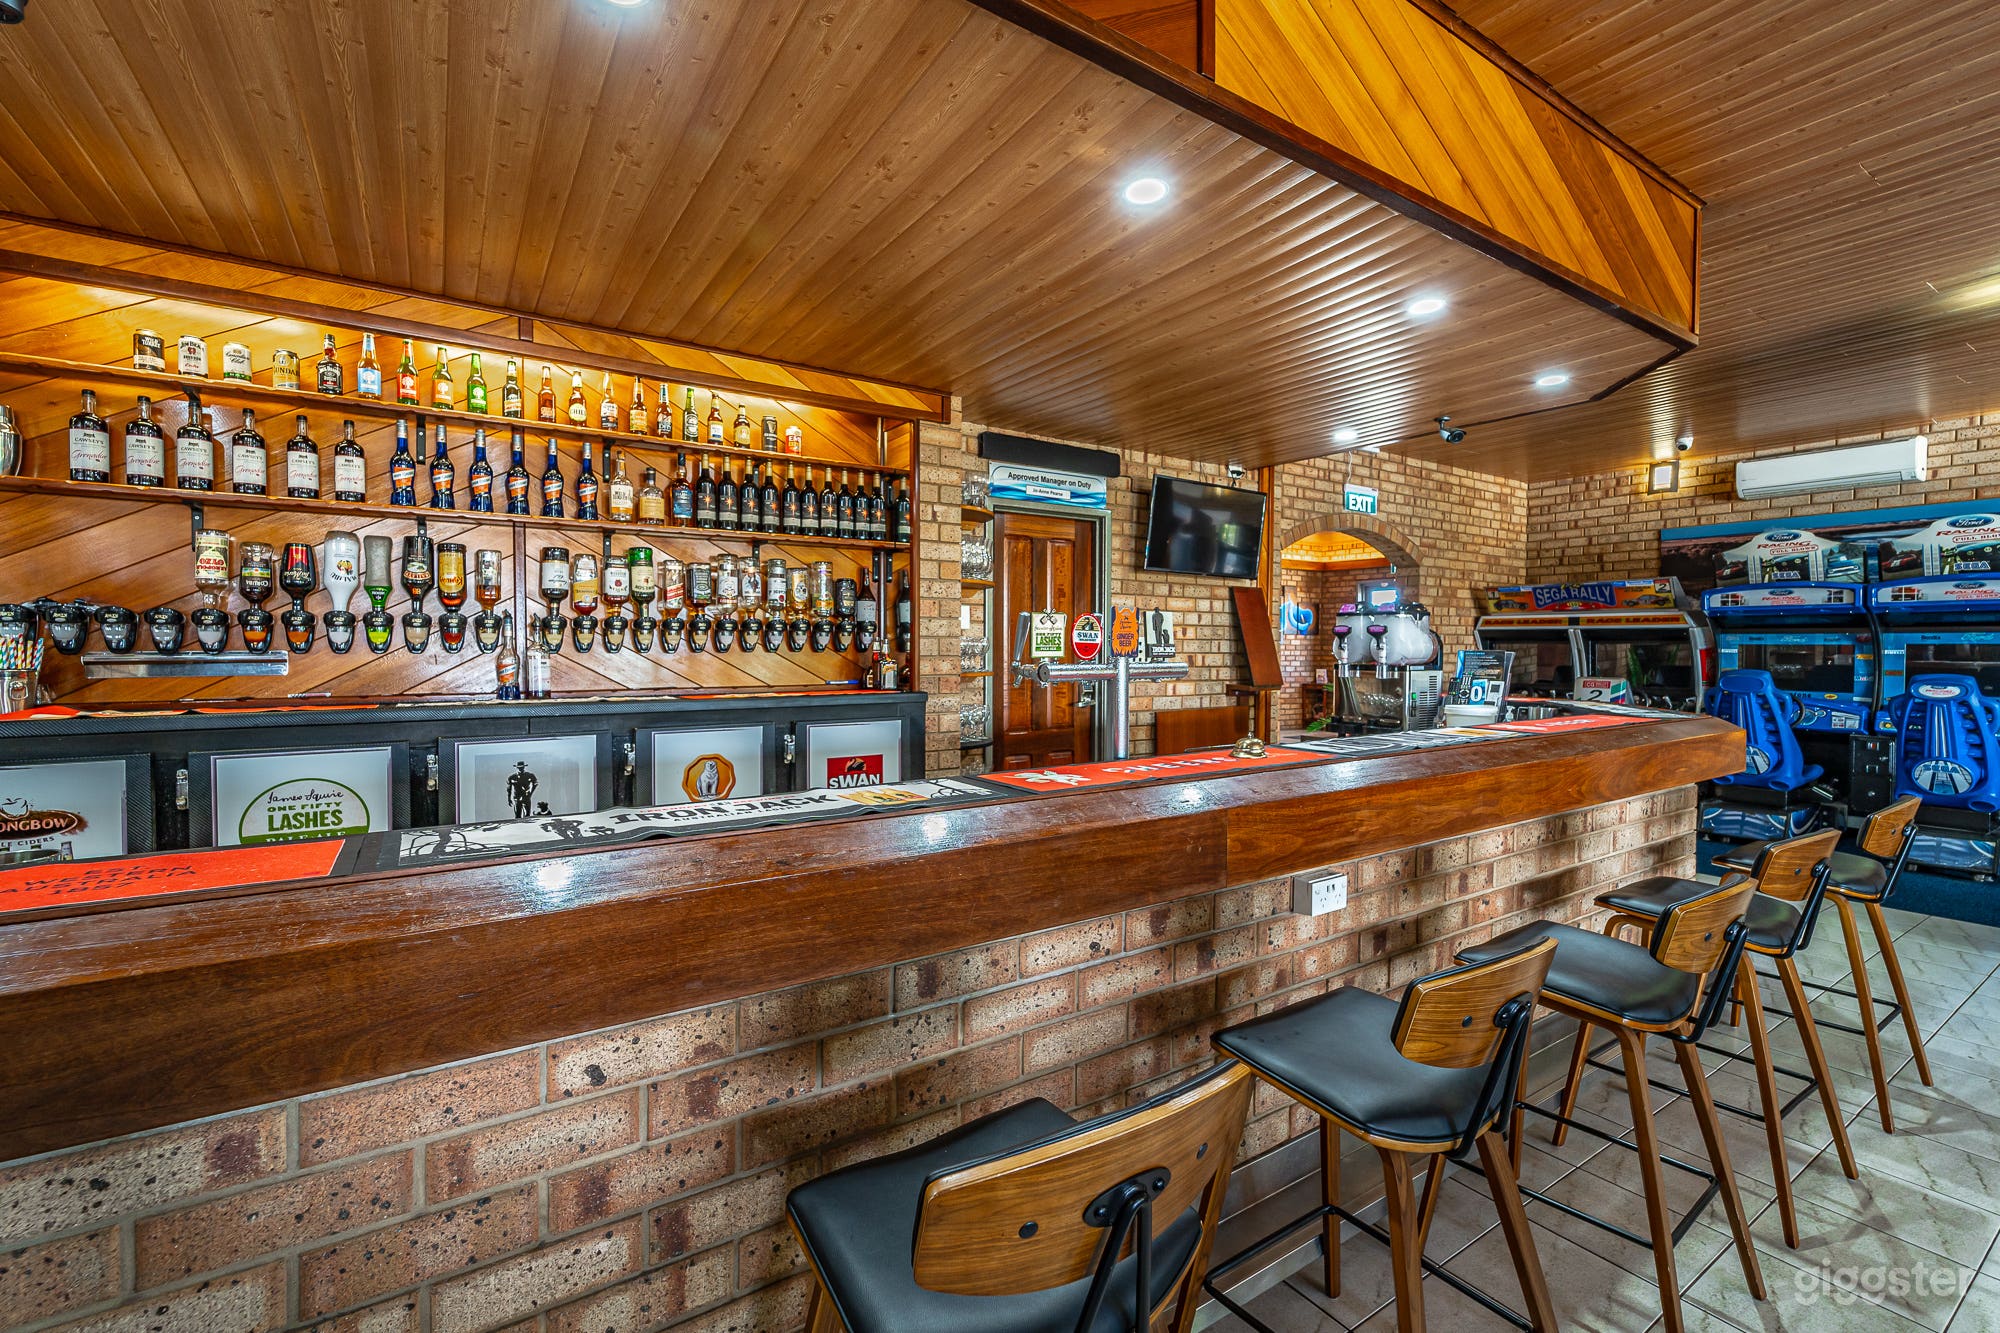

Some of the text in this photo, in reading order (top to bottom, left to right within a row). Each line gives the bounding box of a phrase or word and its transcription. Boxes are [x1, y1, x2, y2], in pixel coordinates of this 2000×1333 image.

[1007, 471, 1040, 483] Approved
[1040, 475, 1068, 487] Manager
[1077, 481, 1092, 490] Duty
[1348, 493, 1374, 513] EXIT
[1955, 517, 1984, 527] Ford
[1771, 532, 1794, 541] Ford
[1757, 540, 1813, 550] RACING
[1954, 561, 1991, 571] SEGA
[1771, 571, 1801, 580] SEGA
[1535, 584, 1612, 607] SEGA RALLY
[1035, 636, 1062, 646] LASHES
[1076, 631, 1099, 639] SWAN
[1116, 632, 1135, 640] GINGER
[1921, 764, 1960, 774] SEGA
[829, 773, 881, 789] SWAN
[267, 791, 303, 804] James
[266, 801, 343, 813] ONE FIFTY
[608, 806, 731, 825] IRON
[732, 794, 839, 812] JACK
[673, 805, 803, 822] AUSTRALIAN LAGERS
[0, 817, 68, 833] ONGBOW
[267, 808, 344, 832] LASHES
[17, 835, 55, 847] CIDERS
[25, 865, 192, 886] WESTERN
[0, 870, 197, 894] AUSTRALIA
